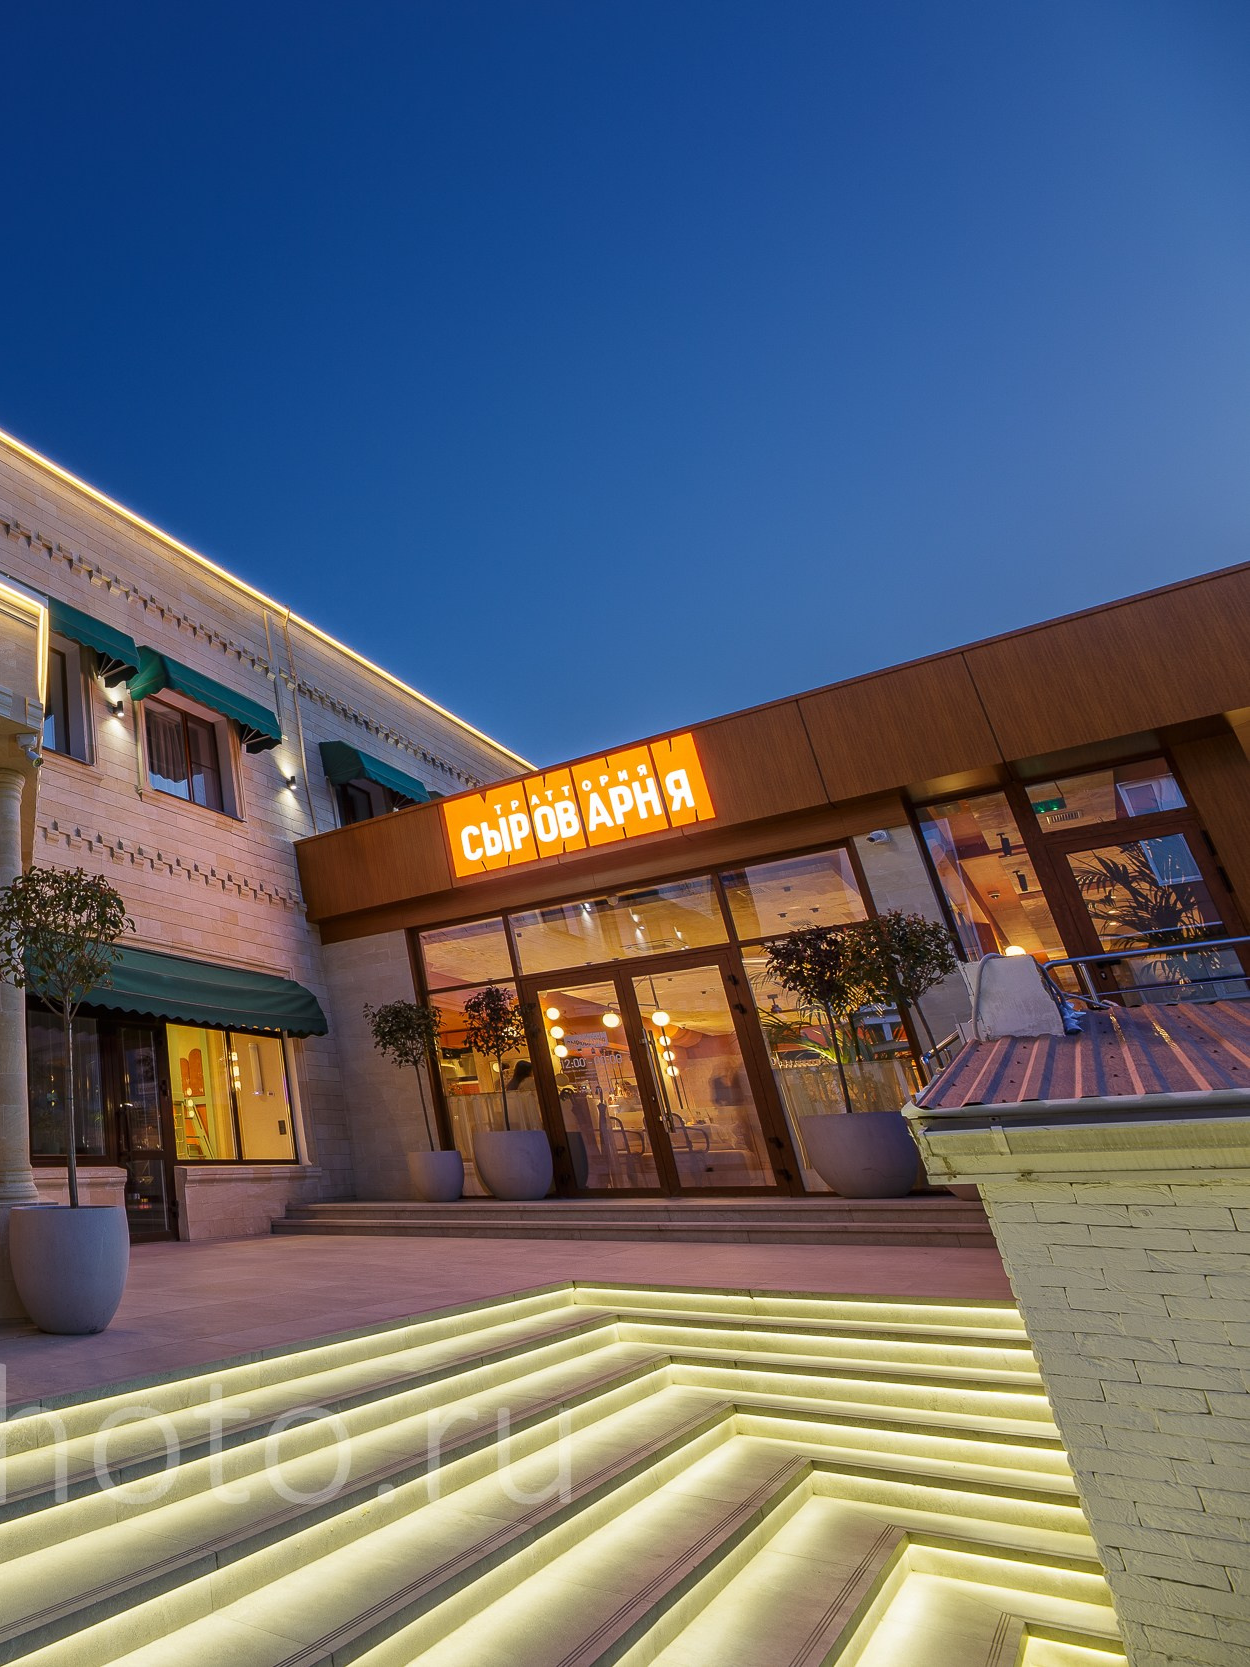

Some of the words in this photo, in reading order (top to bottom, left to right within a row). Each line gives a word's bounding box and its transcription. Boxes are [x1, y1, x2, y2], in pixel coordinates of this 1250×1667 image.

[460, 768, 696, 861] СЫРОВАРНЯ
[493, 763, 649, 816] ТРАТТОРИЯ
[560, 1057, 586, 1069] 12:00
